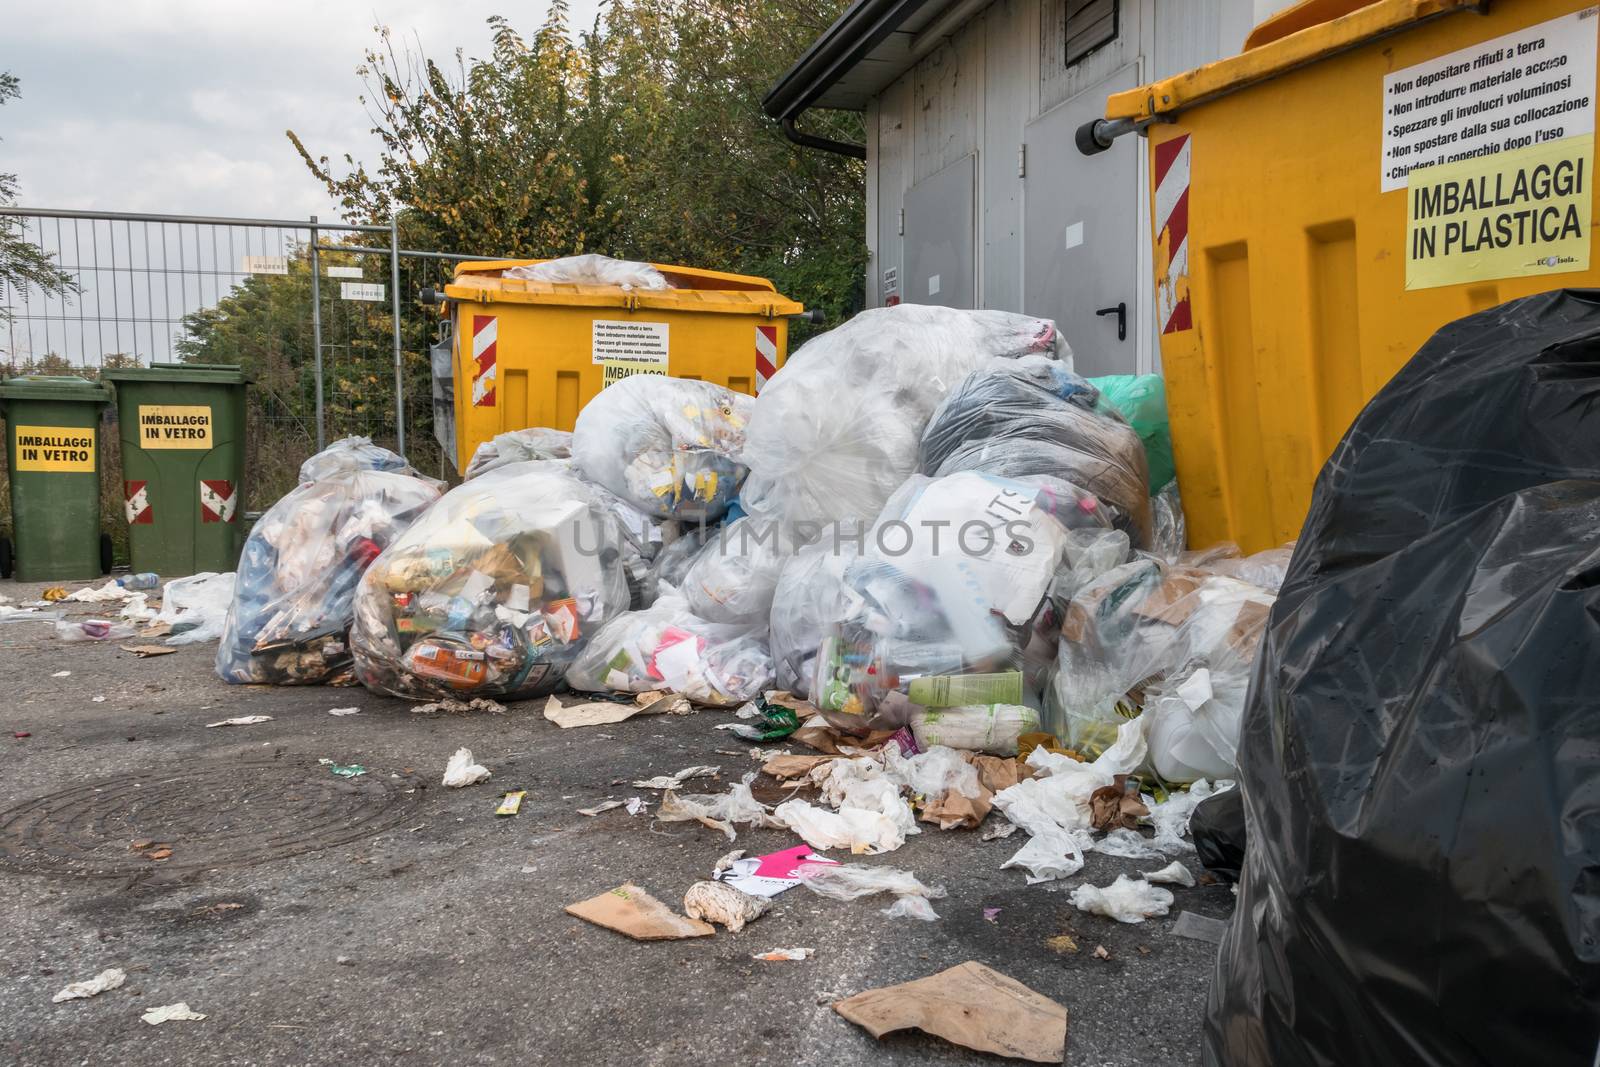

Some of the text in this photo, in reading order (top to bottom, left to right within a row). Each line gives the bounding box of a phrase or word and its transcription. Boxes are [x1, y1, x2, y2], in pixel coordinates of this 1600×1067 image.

[1394, 38, 1545, 94] Non depositare rifiuti a terra
[1394, 55, 1568, 116] Non introdurre materiale acceso
[1392, 96, 1589, 158] Non spostare dalla sua collocazione
[1393, 74, 1572, 138] Spezzare gli involucri voluminosi
[1504, 135, 1532, 151] dopo
[1414, 158, 1584, 220] IMBALLAGGI
[1412, 204, 1582, 260] IN PLASTICA
[18, 436, 92, 448] IMBALLAGGI
[142, 415, 209, 426] IMBALLAGGI
[146, 428, 206, 439] IN VETRO
[22, 449, 88, 462] IN VETRO
